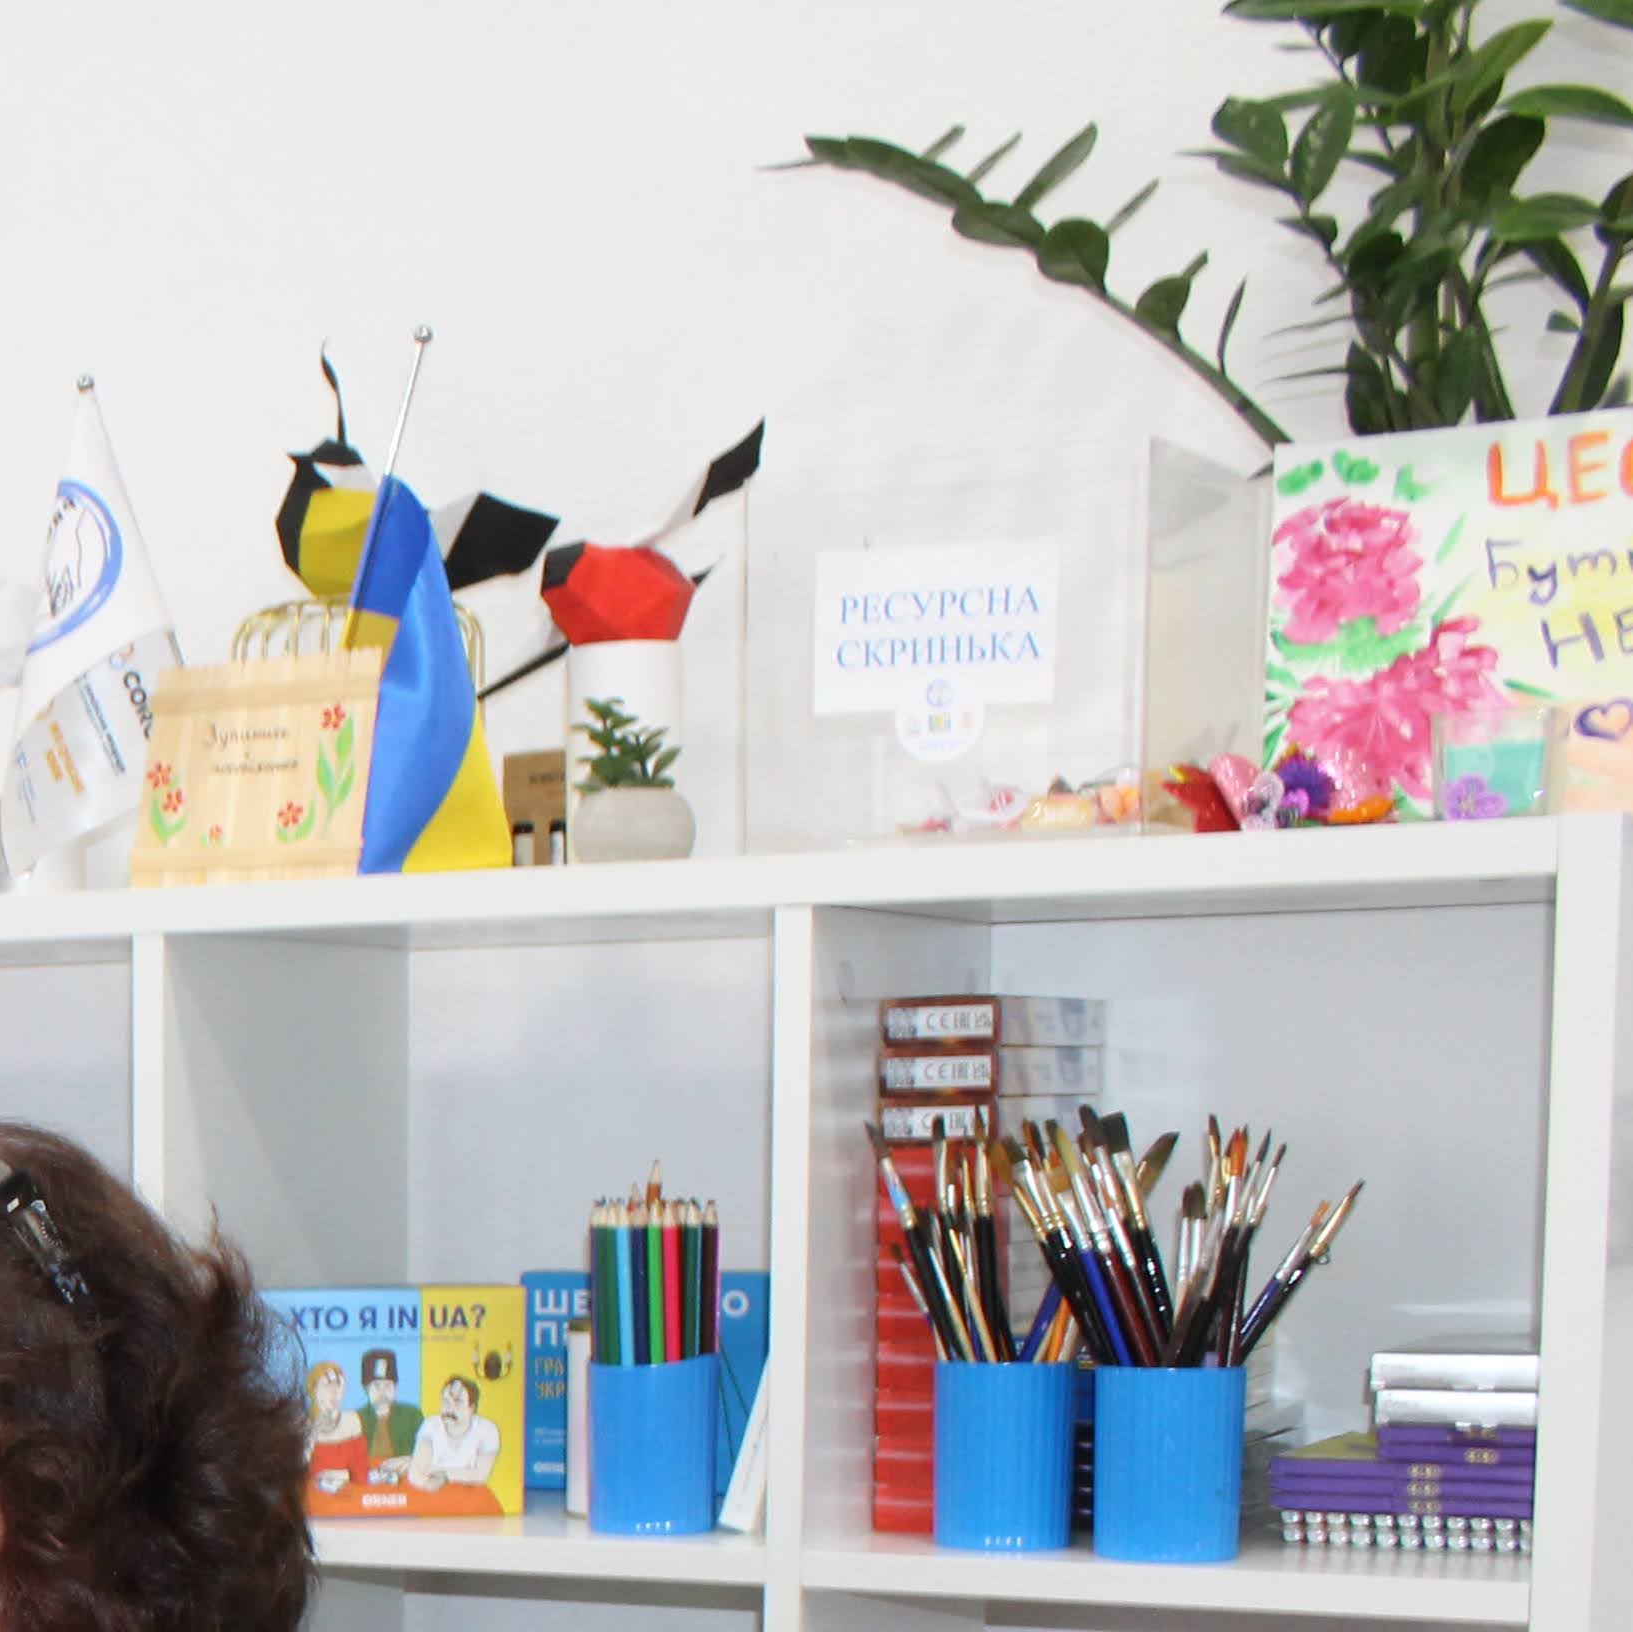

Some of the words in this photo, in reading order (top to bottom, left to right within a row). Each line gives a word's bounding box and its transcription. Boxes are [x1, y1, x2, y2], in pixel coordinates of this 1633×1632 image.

[840, 585, 1040, 625] РЕСУРСНА
[836, 630, 1040, 669] СКРИНЬКА
[290, 1305, 349, 1330] ХТО
[358, 1305, 377, 1330] Я
[429, 1304, 487, 1330] UA?
